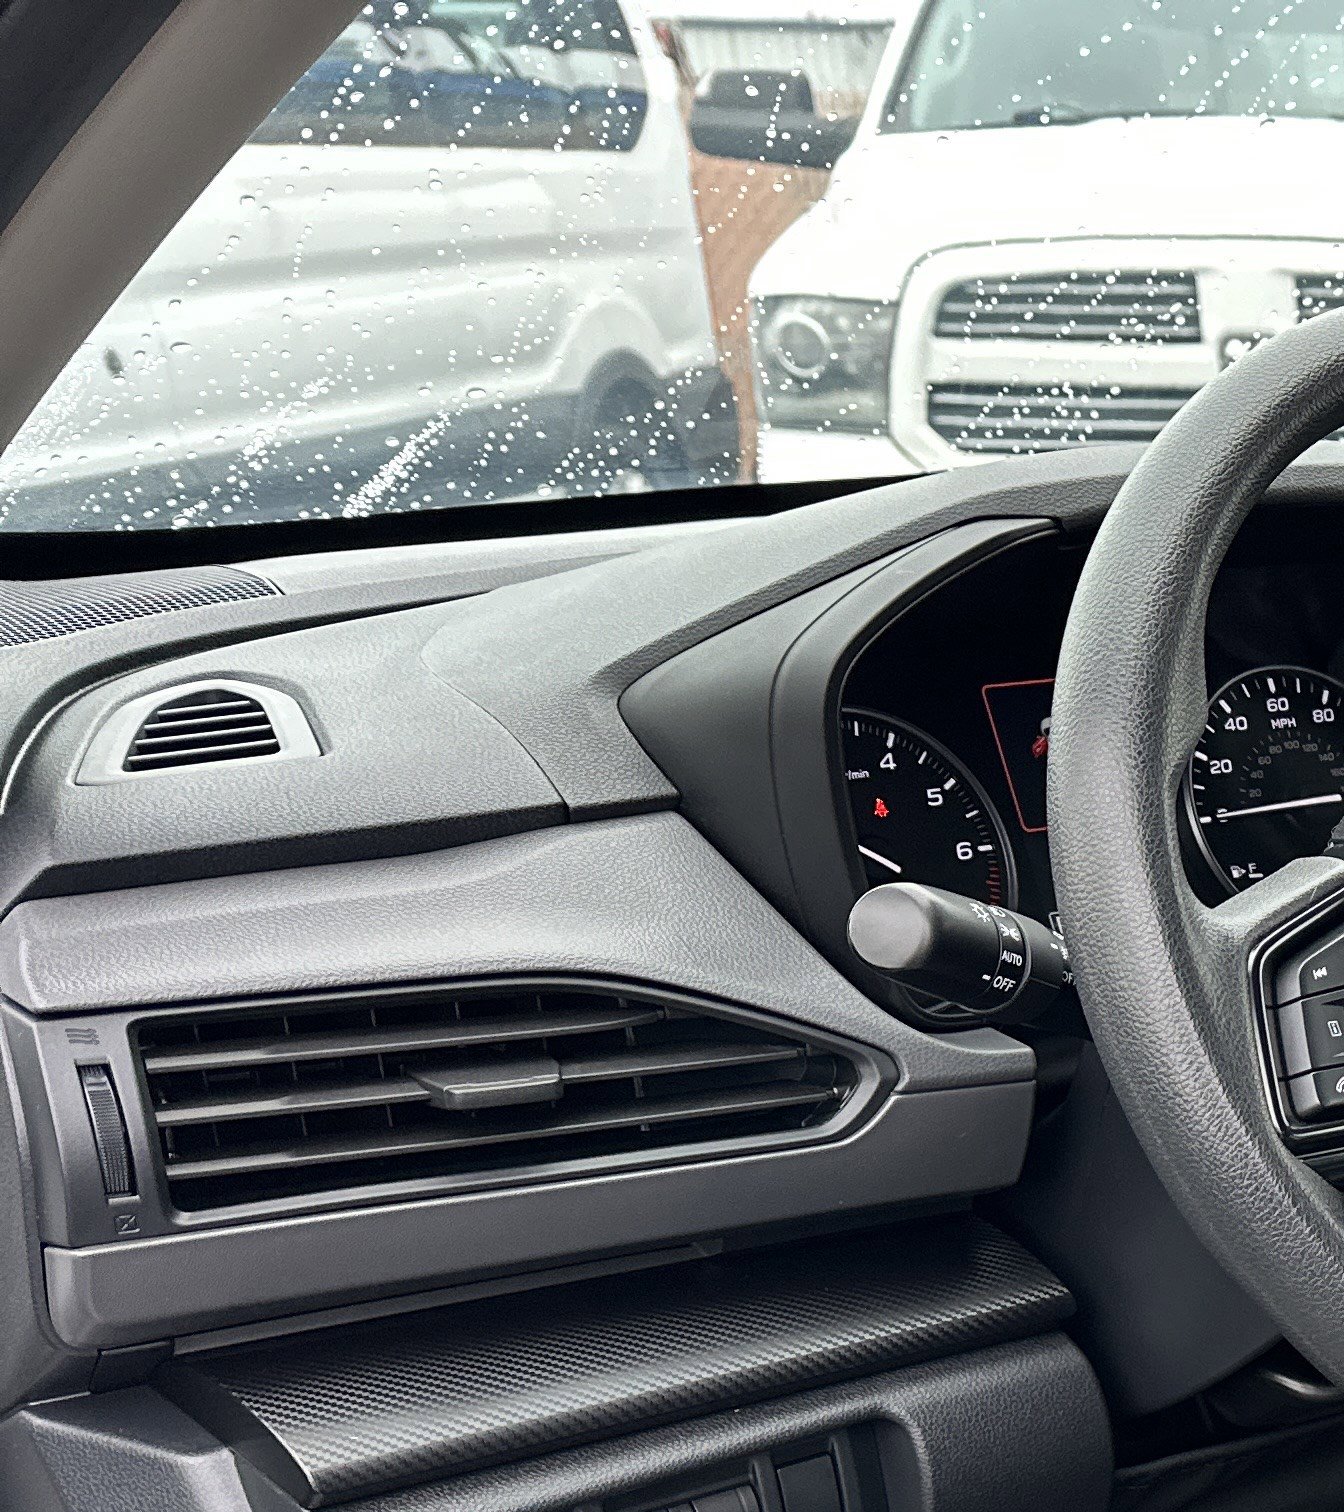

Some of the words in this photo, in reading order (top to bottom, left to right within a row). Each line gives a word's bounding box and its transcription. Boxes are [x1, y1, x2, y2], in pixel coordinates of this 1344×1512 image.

[1266, 697, 1289, 712] 60
[1312, 708, 1335, 723] 80
[1224, 716, 1248, 732] 40
[1271, 717, 1297, 730] MPH
[1283, 740, 1300, 751] 100
[1301, 743, 1319, 752] 120
[879, 752, 897, 770] 4
[1257, 755, 1272, 765] 60
[1318, 752, 1335, 762] 140
[1209, 759, 1233, 775] 20
[1250, 769, 1264, 780] 40
[926, 788, 944, 806] 5
[955, 841, 973, 860] 6
[1001, 949, 1023, 967] AUTO
[992, 975, 1017, 992] OFF
